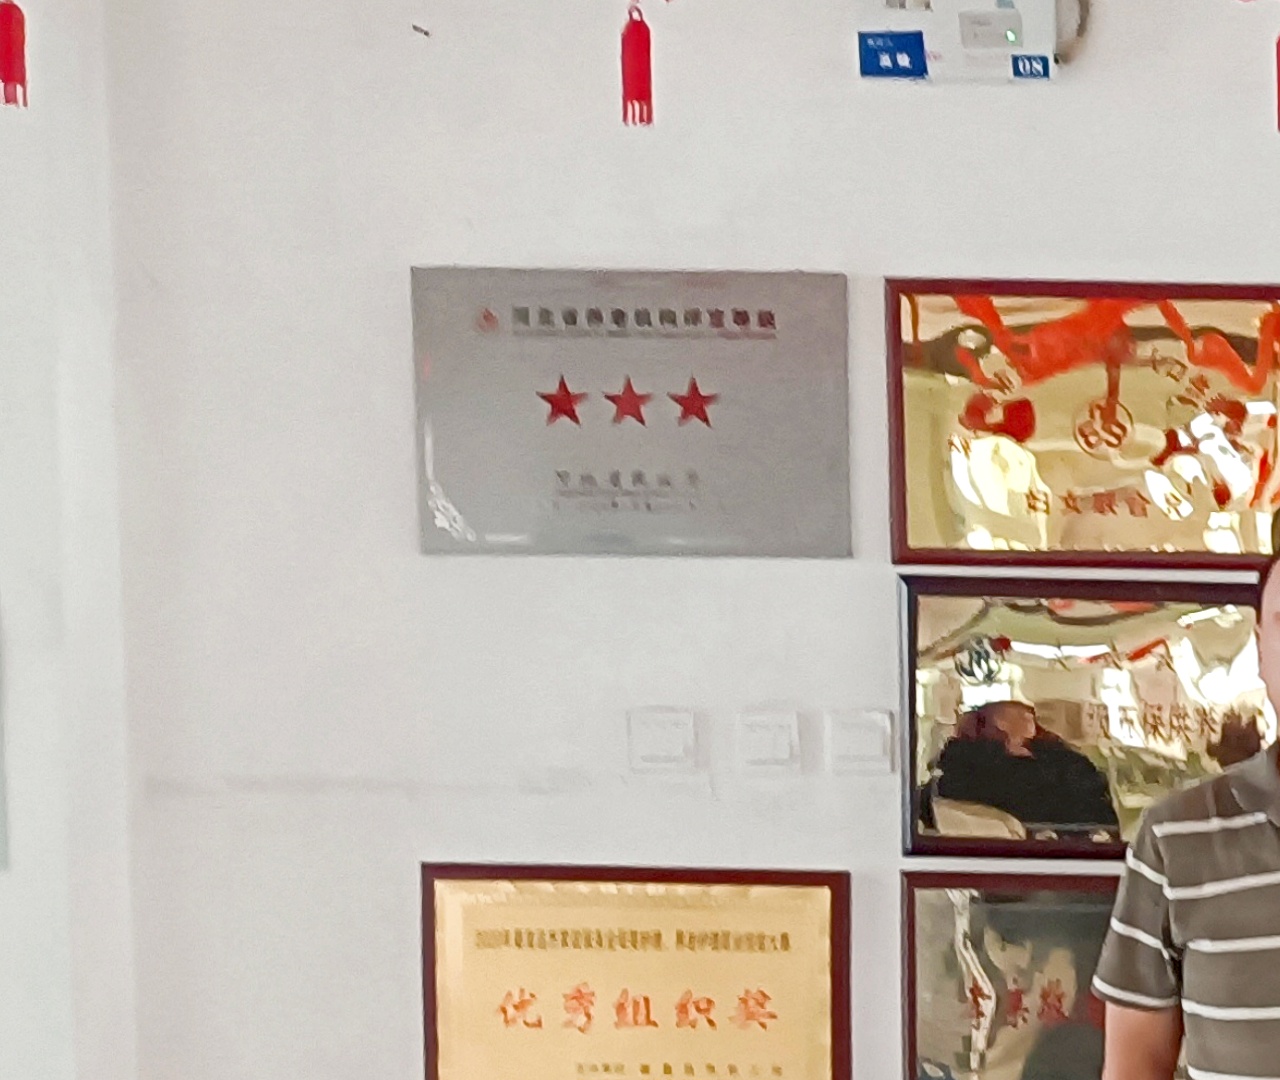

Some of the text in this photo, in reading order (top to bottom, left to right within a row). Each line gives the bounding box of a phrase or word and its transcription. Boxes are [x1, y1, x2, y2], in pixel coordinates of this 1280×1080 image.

[496, 981, 781, 1035] 优秀组织奖
